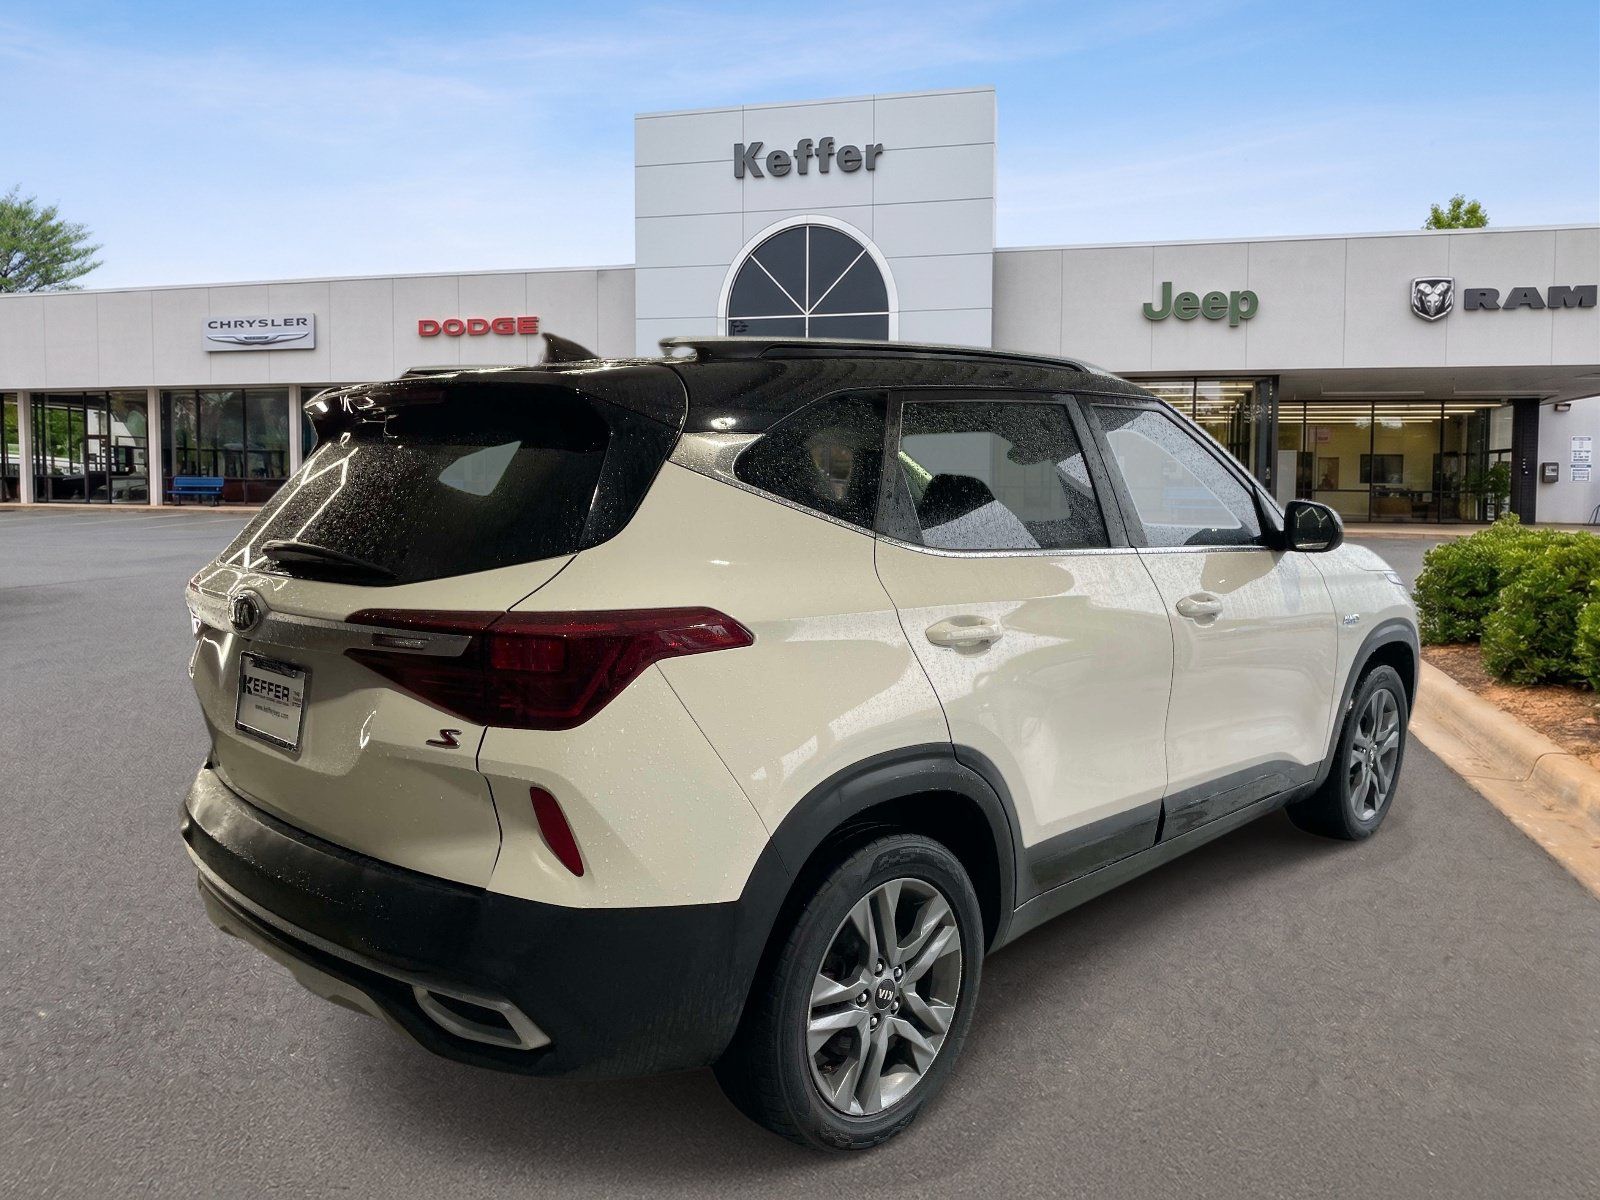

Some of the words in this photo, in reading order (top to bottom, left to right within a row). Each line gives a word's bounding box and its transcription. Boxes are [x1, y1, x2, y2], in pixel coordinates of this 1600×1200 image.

[733, 136, 884, 179] Keffer
[1143, 281, 1259, 328] Jeep
[1464, 285, 1598, 311] RAM
[207, 317, 309, 330] CHRYSLER
[418, 316, 539, 337] DODGE
[242, 674, 290, 702] KEFFER
[426, 728, 462, 749] S
